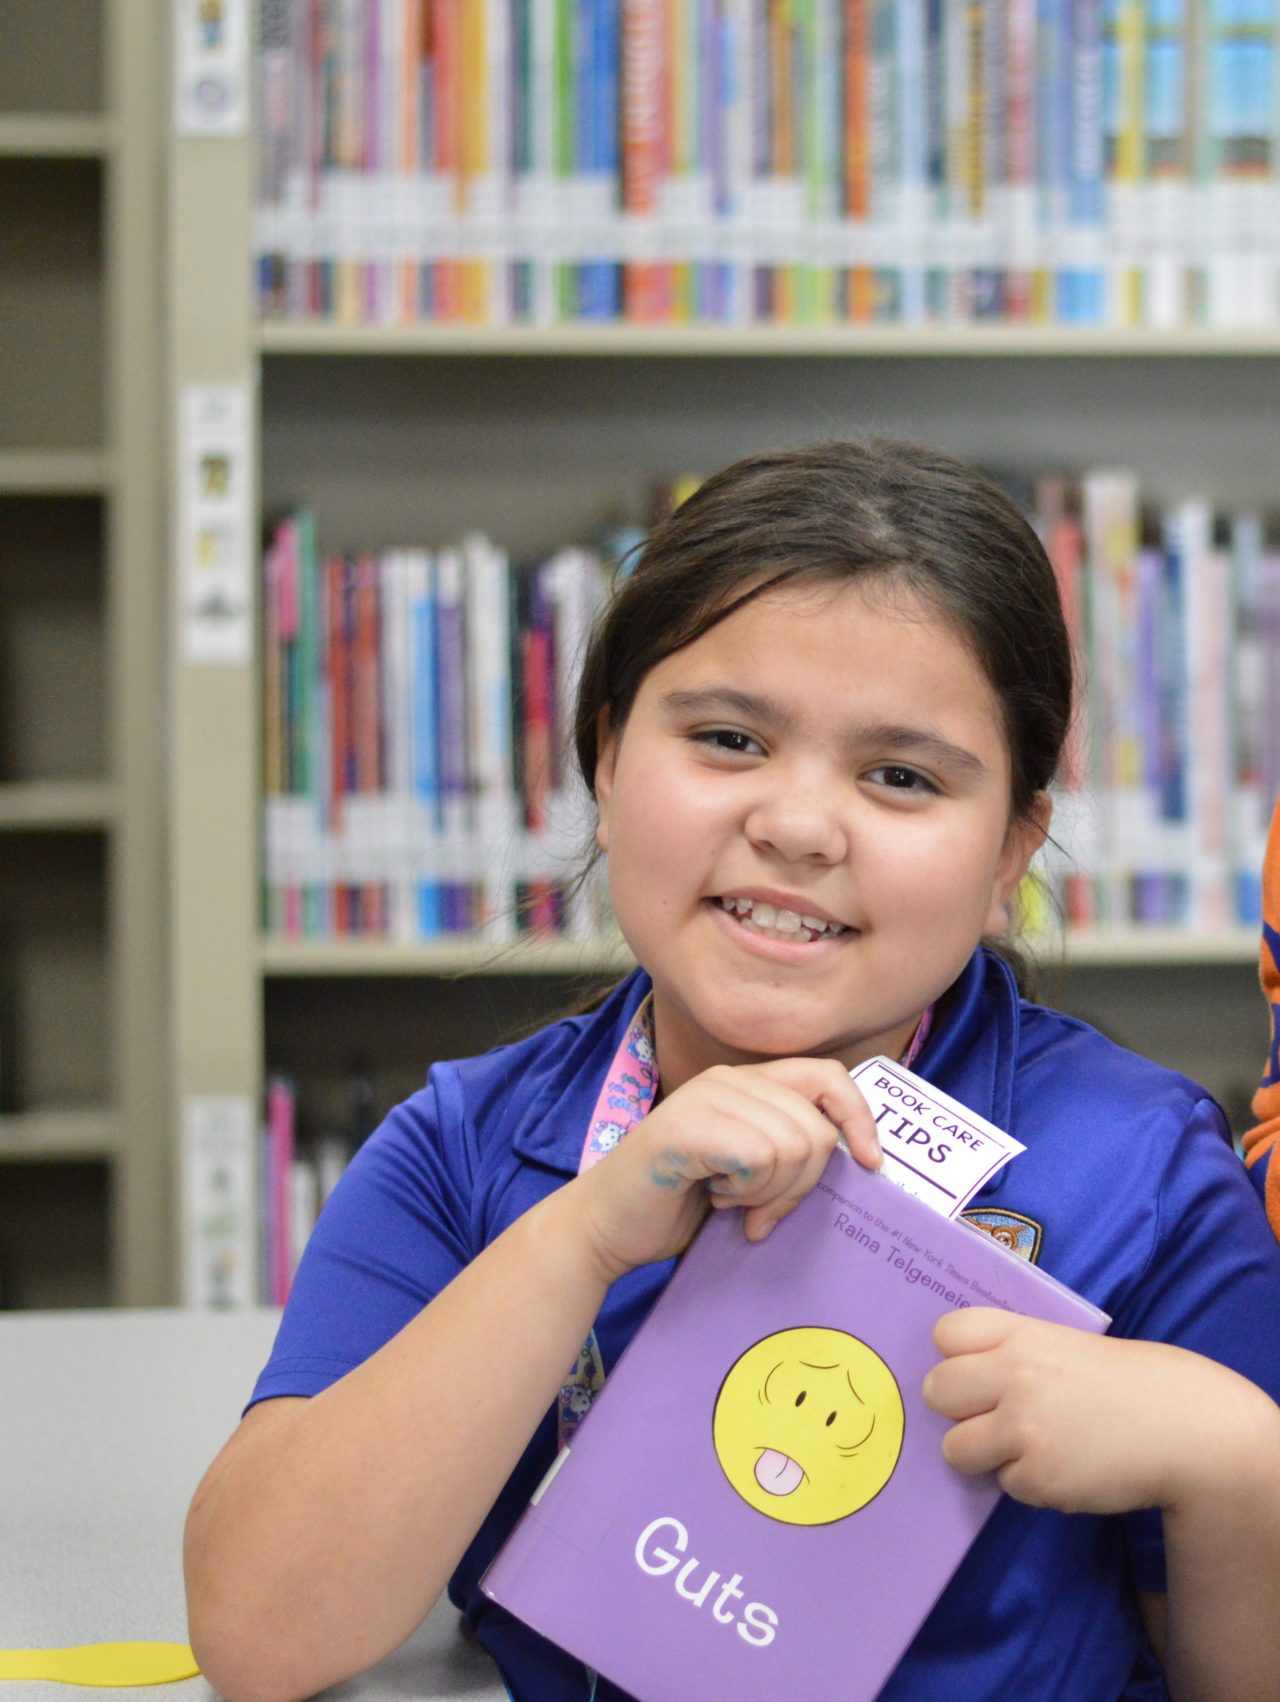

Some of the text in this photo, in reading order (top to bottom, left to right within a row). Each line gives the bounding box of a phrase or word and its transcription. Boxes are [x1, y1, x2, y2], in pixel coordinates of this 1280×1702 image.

[874, 1077, 985, 1152] BOOK CARE
[875, 1103, 953, 1164] TIPS
[816, 1182, 863, 1215] companion
[863, 1210, 874, 1222] to
[874, 1218, 890, 1233] the
[890, 1229, 903, 1240] #1
[902, 1236, 922, 1253] New
[923, 1248, 944, 1268] York
[945, 1263, 970, 1285] Times
[834, 1212, 971, 1309] Raina Telgemeie
[634, 1516, 780, 1648] Guts
